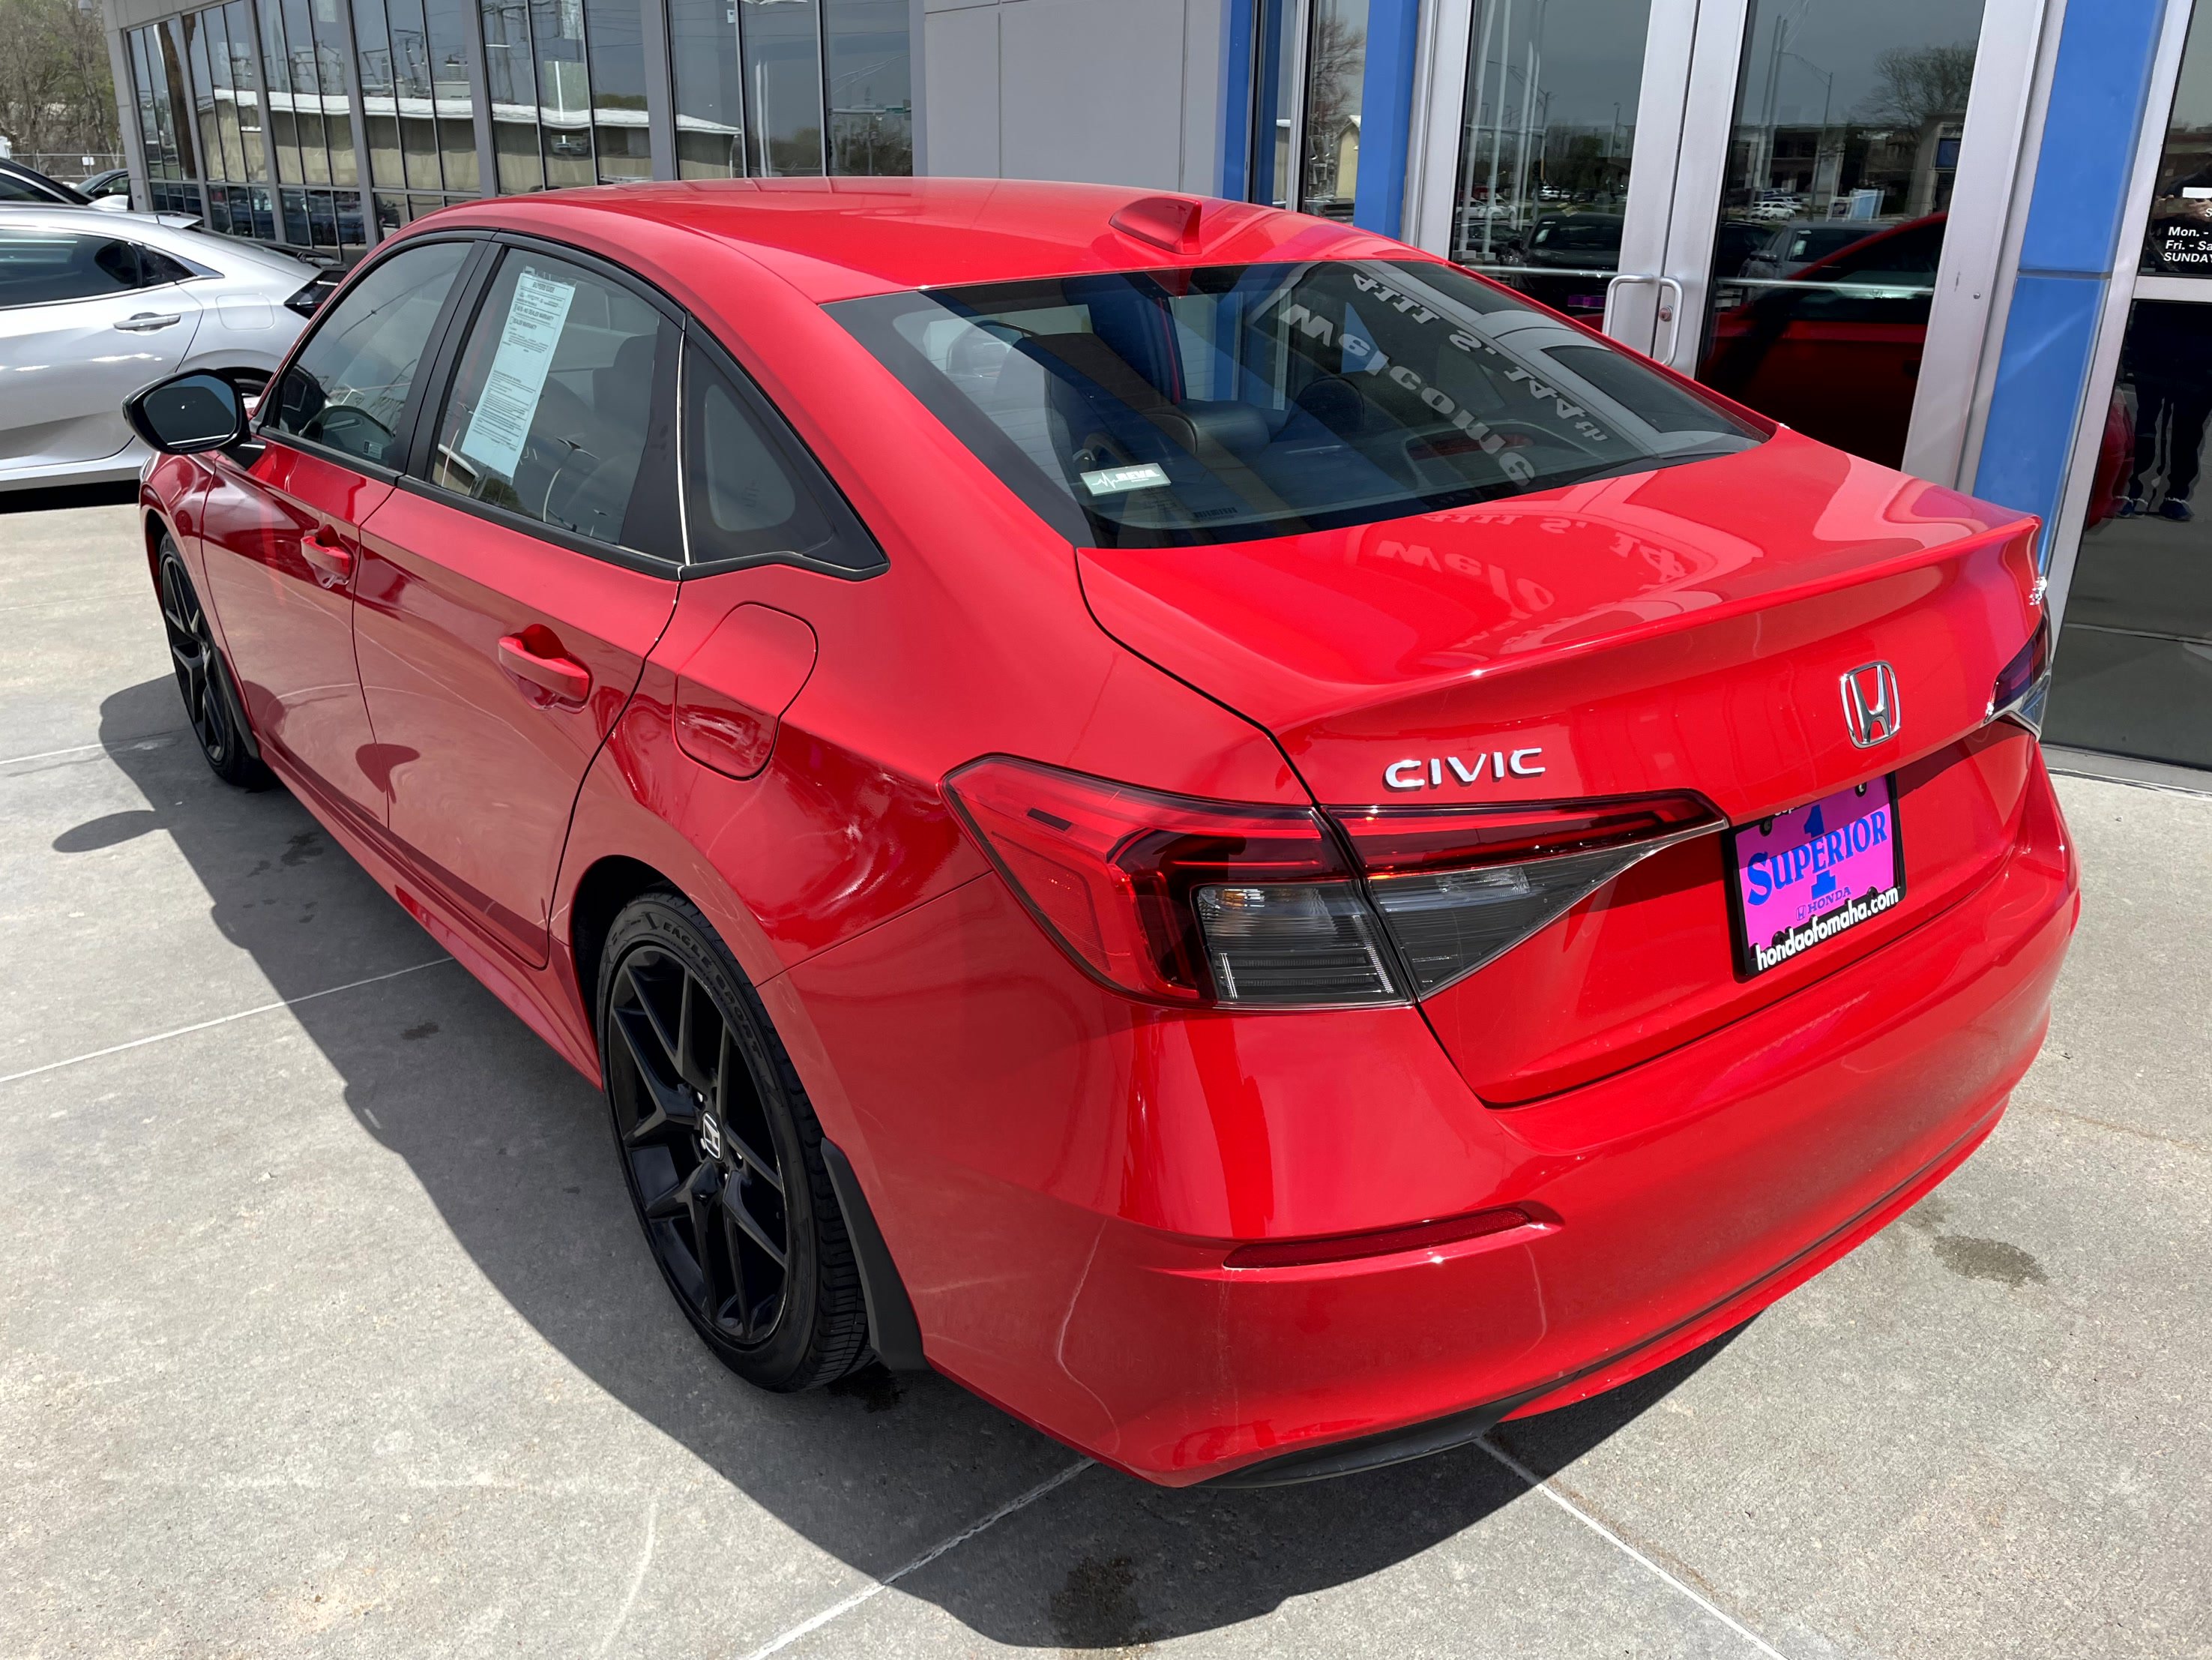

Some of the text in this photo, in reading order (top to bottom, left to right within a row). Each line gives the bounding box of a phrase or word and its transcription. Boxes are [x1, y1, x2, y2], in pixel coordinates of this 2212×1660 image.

[2166, 240, 2185, 250] Fri.
[2168, 226, 2200, 237] Mon.
[1385, 748, 1546, 788] CIVIC
[1747, 811, 1887, 906] SUPERIOR
[1807, 886, 1851, 914] HONDA
[1756, 887, 1899, 971] hondaofomaha.com
